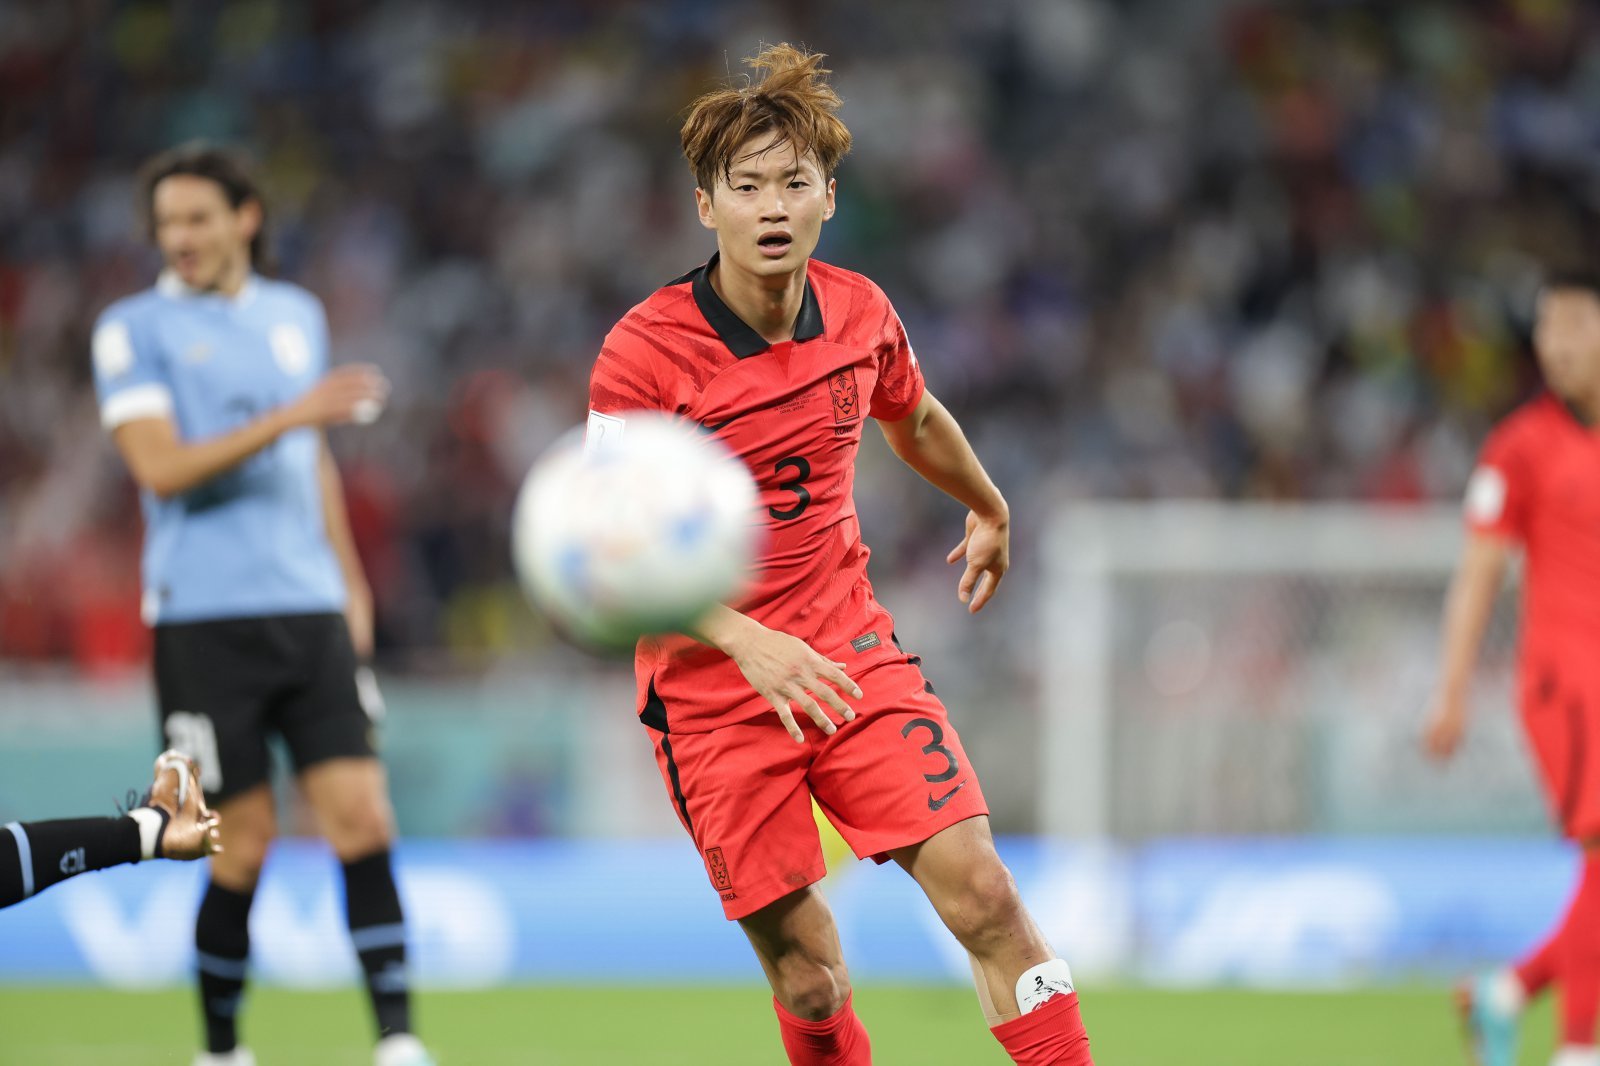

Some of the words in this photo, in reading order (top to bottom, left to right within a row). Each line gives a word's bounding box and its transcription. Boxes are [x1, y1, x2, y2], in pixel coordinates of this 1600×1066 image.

[769, 456, 811, 521] 3
[901, 718, 959, 783] 3
[1034, 975, 1044, 992] 3
